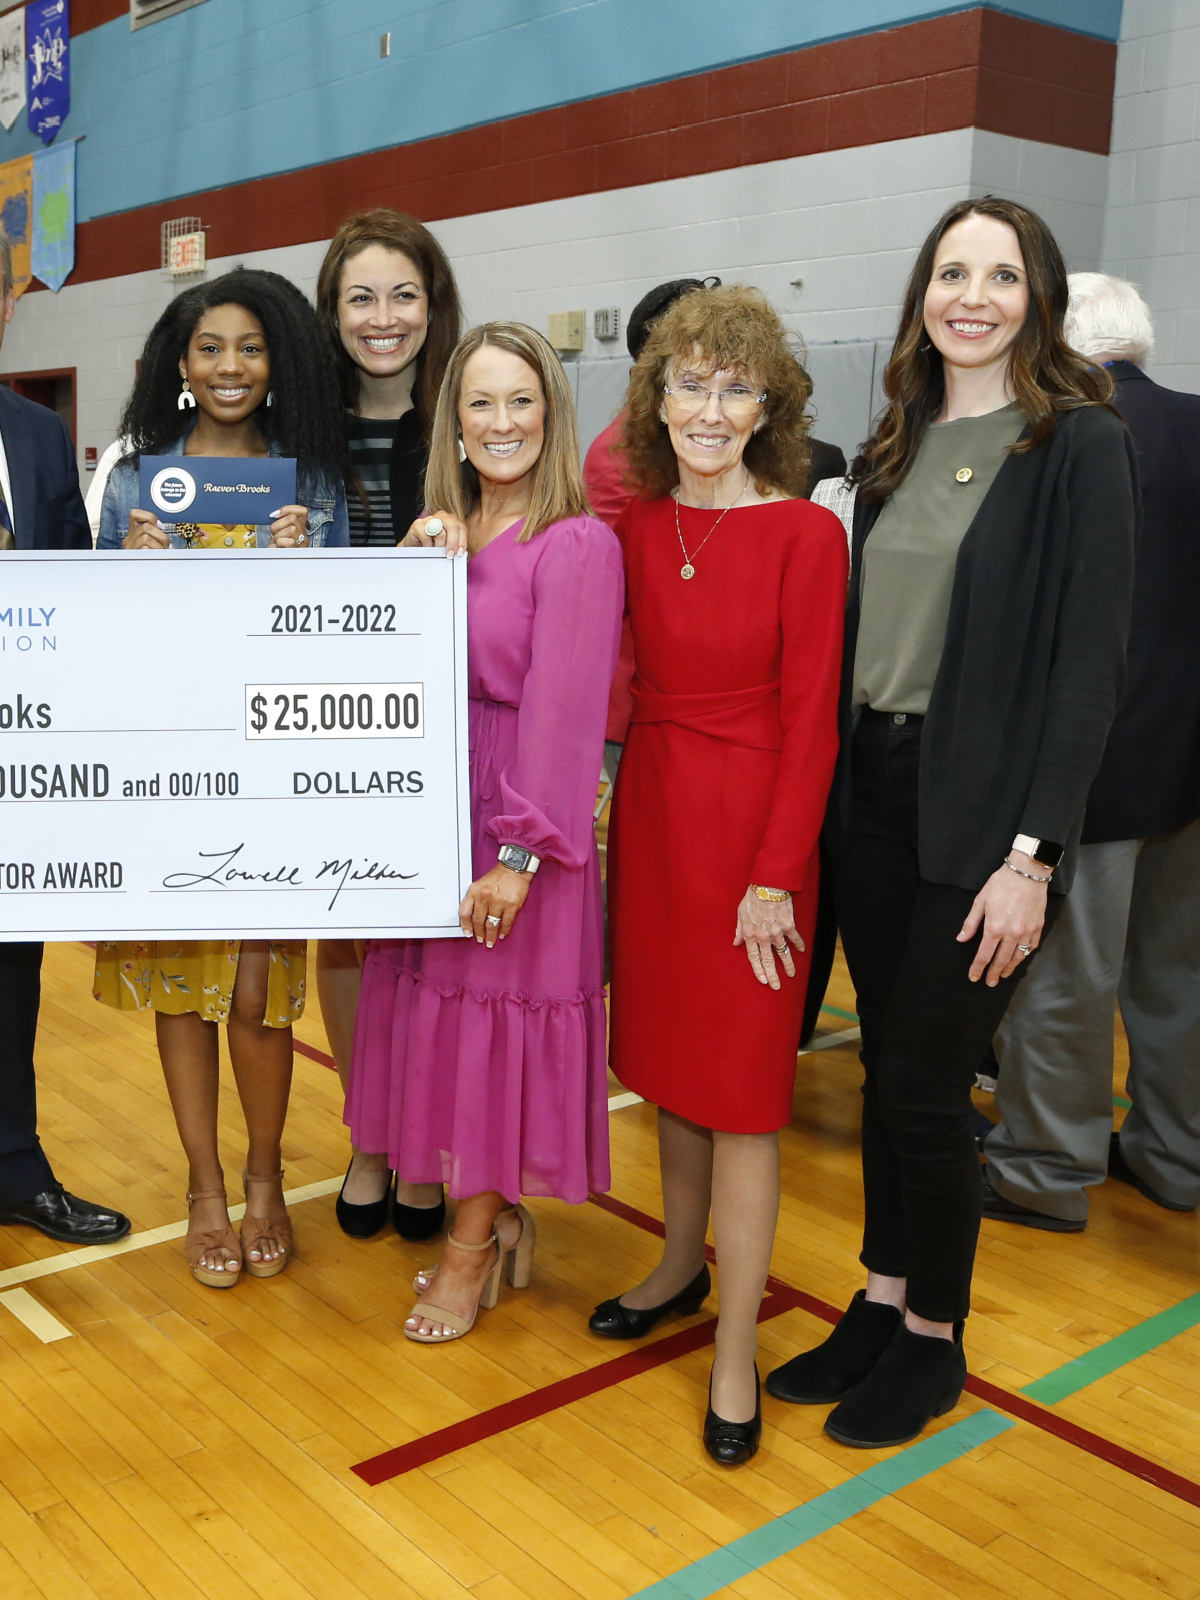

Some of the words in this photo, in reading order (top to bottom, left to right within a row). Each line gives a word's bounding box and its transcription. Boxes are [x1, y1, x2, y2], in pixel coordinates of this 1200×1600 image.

[204, 483, 235, 493] Raeven
[236, 484, 271, 493] Brooks
[271, 604, 397, 632] 2021-2022
[251, 692, 419, 734] $25,000.00
[123, 773, 160, 797] and
[169, 772, 239, 796] 00/100
[293, 771, 424, 794] DOLLARS
[43, 862, 123, 888] AWARD
[163, 843, 303, 888] Lowell
[315, 858, 419, 911] Milken
